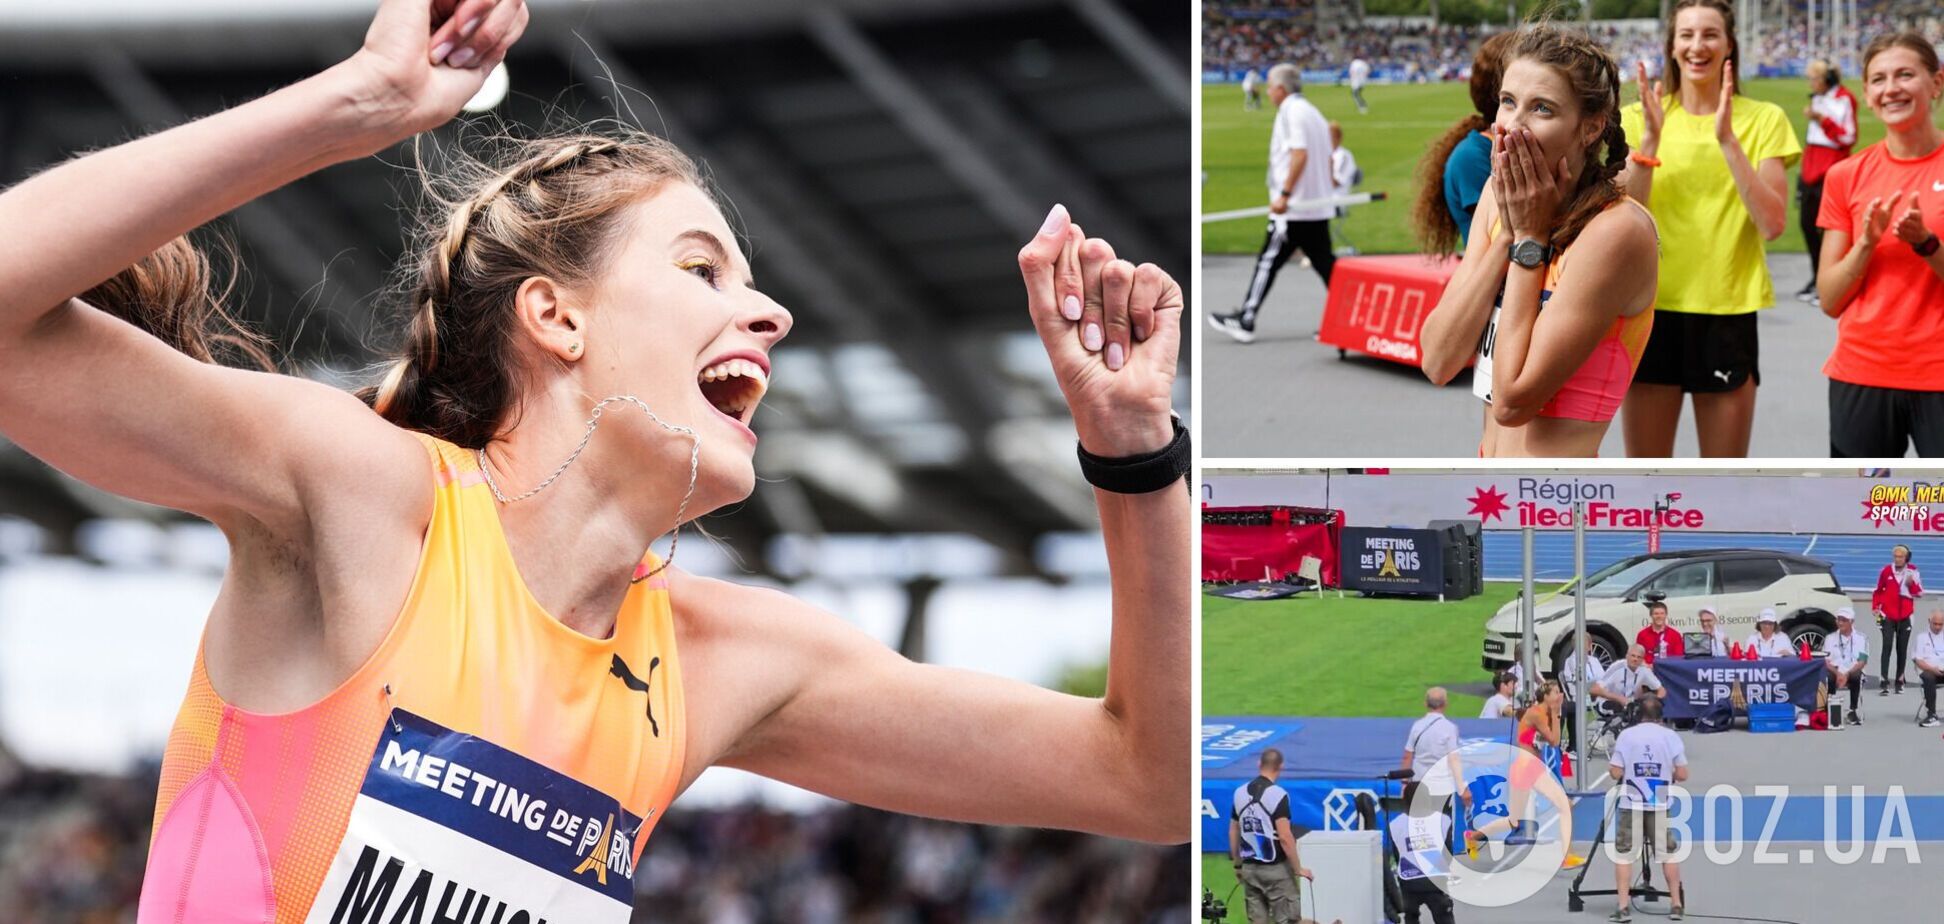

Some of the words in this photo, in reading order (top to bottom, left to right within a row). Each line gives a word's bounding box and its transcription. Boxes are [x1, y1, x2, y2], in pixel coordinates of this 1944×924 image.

[1349, 283, 1426, 339] 1:00
[1519, 478, 1615, 505] Région
[1366, 537, 1415, 551] MEETING
[1360, 554, 1374, 565] DE
[1375, 550, 1421, 577] PARIS
[1727, 615, 1761, 626] second
[1697, 668, 1780, 684] MEETING
[1689, 689, 1709, 701] DE
[1713, 682, 1790, 707] PARIS
[379, 739, 548, 832] MEETING
[550, 807, 583, 838] DE
[575, 814, 634, 885] PARIS
